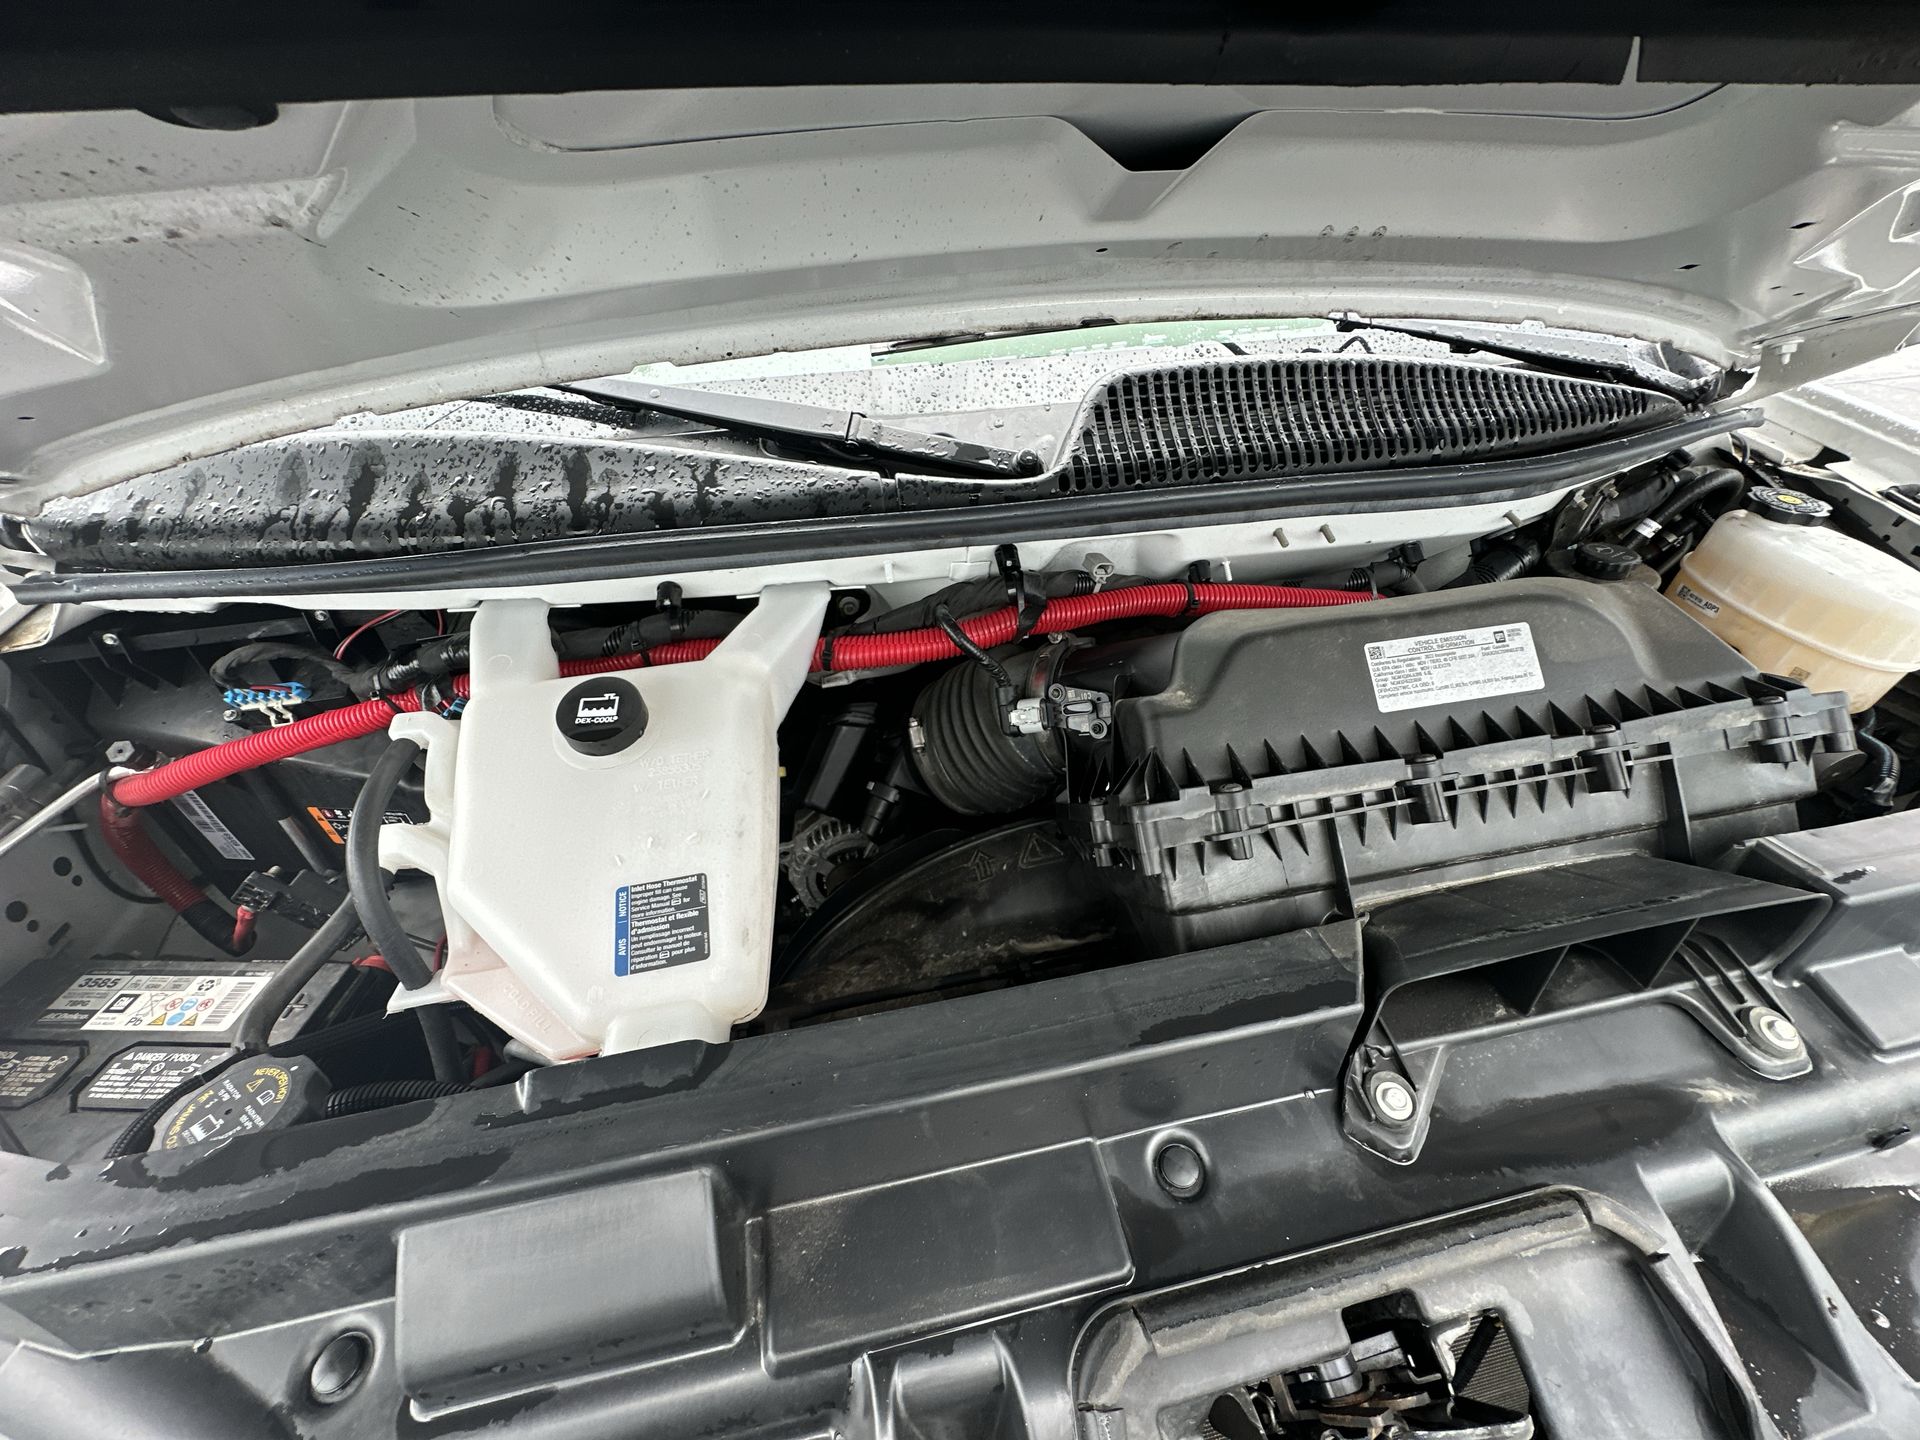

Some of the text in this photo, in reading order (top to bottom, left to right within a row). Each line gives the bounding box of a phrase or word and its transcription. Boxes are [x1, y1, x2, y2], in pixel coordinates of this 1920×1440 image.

[1407, 640, 1475, 654] CONTROL INFORMATION
[1414, 637, 1440, 646] VEHICLE
[631, 885, 646, 893] Inlet
[646, 882, 662, 890] Hose
[662, 875, 697, 887] Thermostat
[631, 890, 654, 900] Improper
[618, 890, 627, 917] NOTICE
[631, 904, 651, 912] Service
[631, 917, 667, 928] Thermostat
[676, 910, 699, 920] flexible
[631, 923, 670, 935] d'admission
[639, 930, 671, 941] remplissage
[671, 925, 695, 934] incorrect
[618, 938, 627, 956] AVIS
[631, 942, 643, 950] peut
[643, 936, 677, 947] endommager
[683, 931, 703, 940] moteur.
[631, 947, 656, 956] Consulter
[662, 941, 683, 950] manuel
[671, 948, 684, 956] pour
[684, 946, 696, 954] plus
[79, 977, 121, 988] 3585
[124, 1017, 143, 1026] Pb
[132, 1052, 168, 1062] DANGER
[170, 1052, 201, 1062] POISON
[253, 1067, 277, 1076] NEVER
[222, 1079, 242, 1100] RADIATOR
[244, 1105, 266, 1127] RADIATEUR
